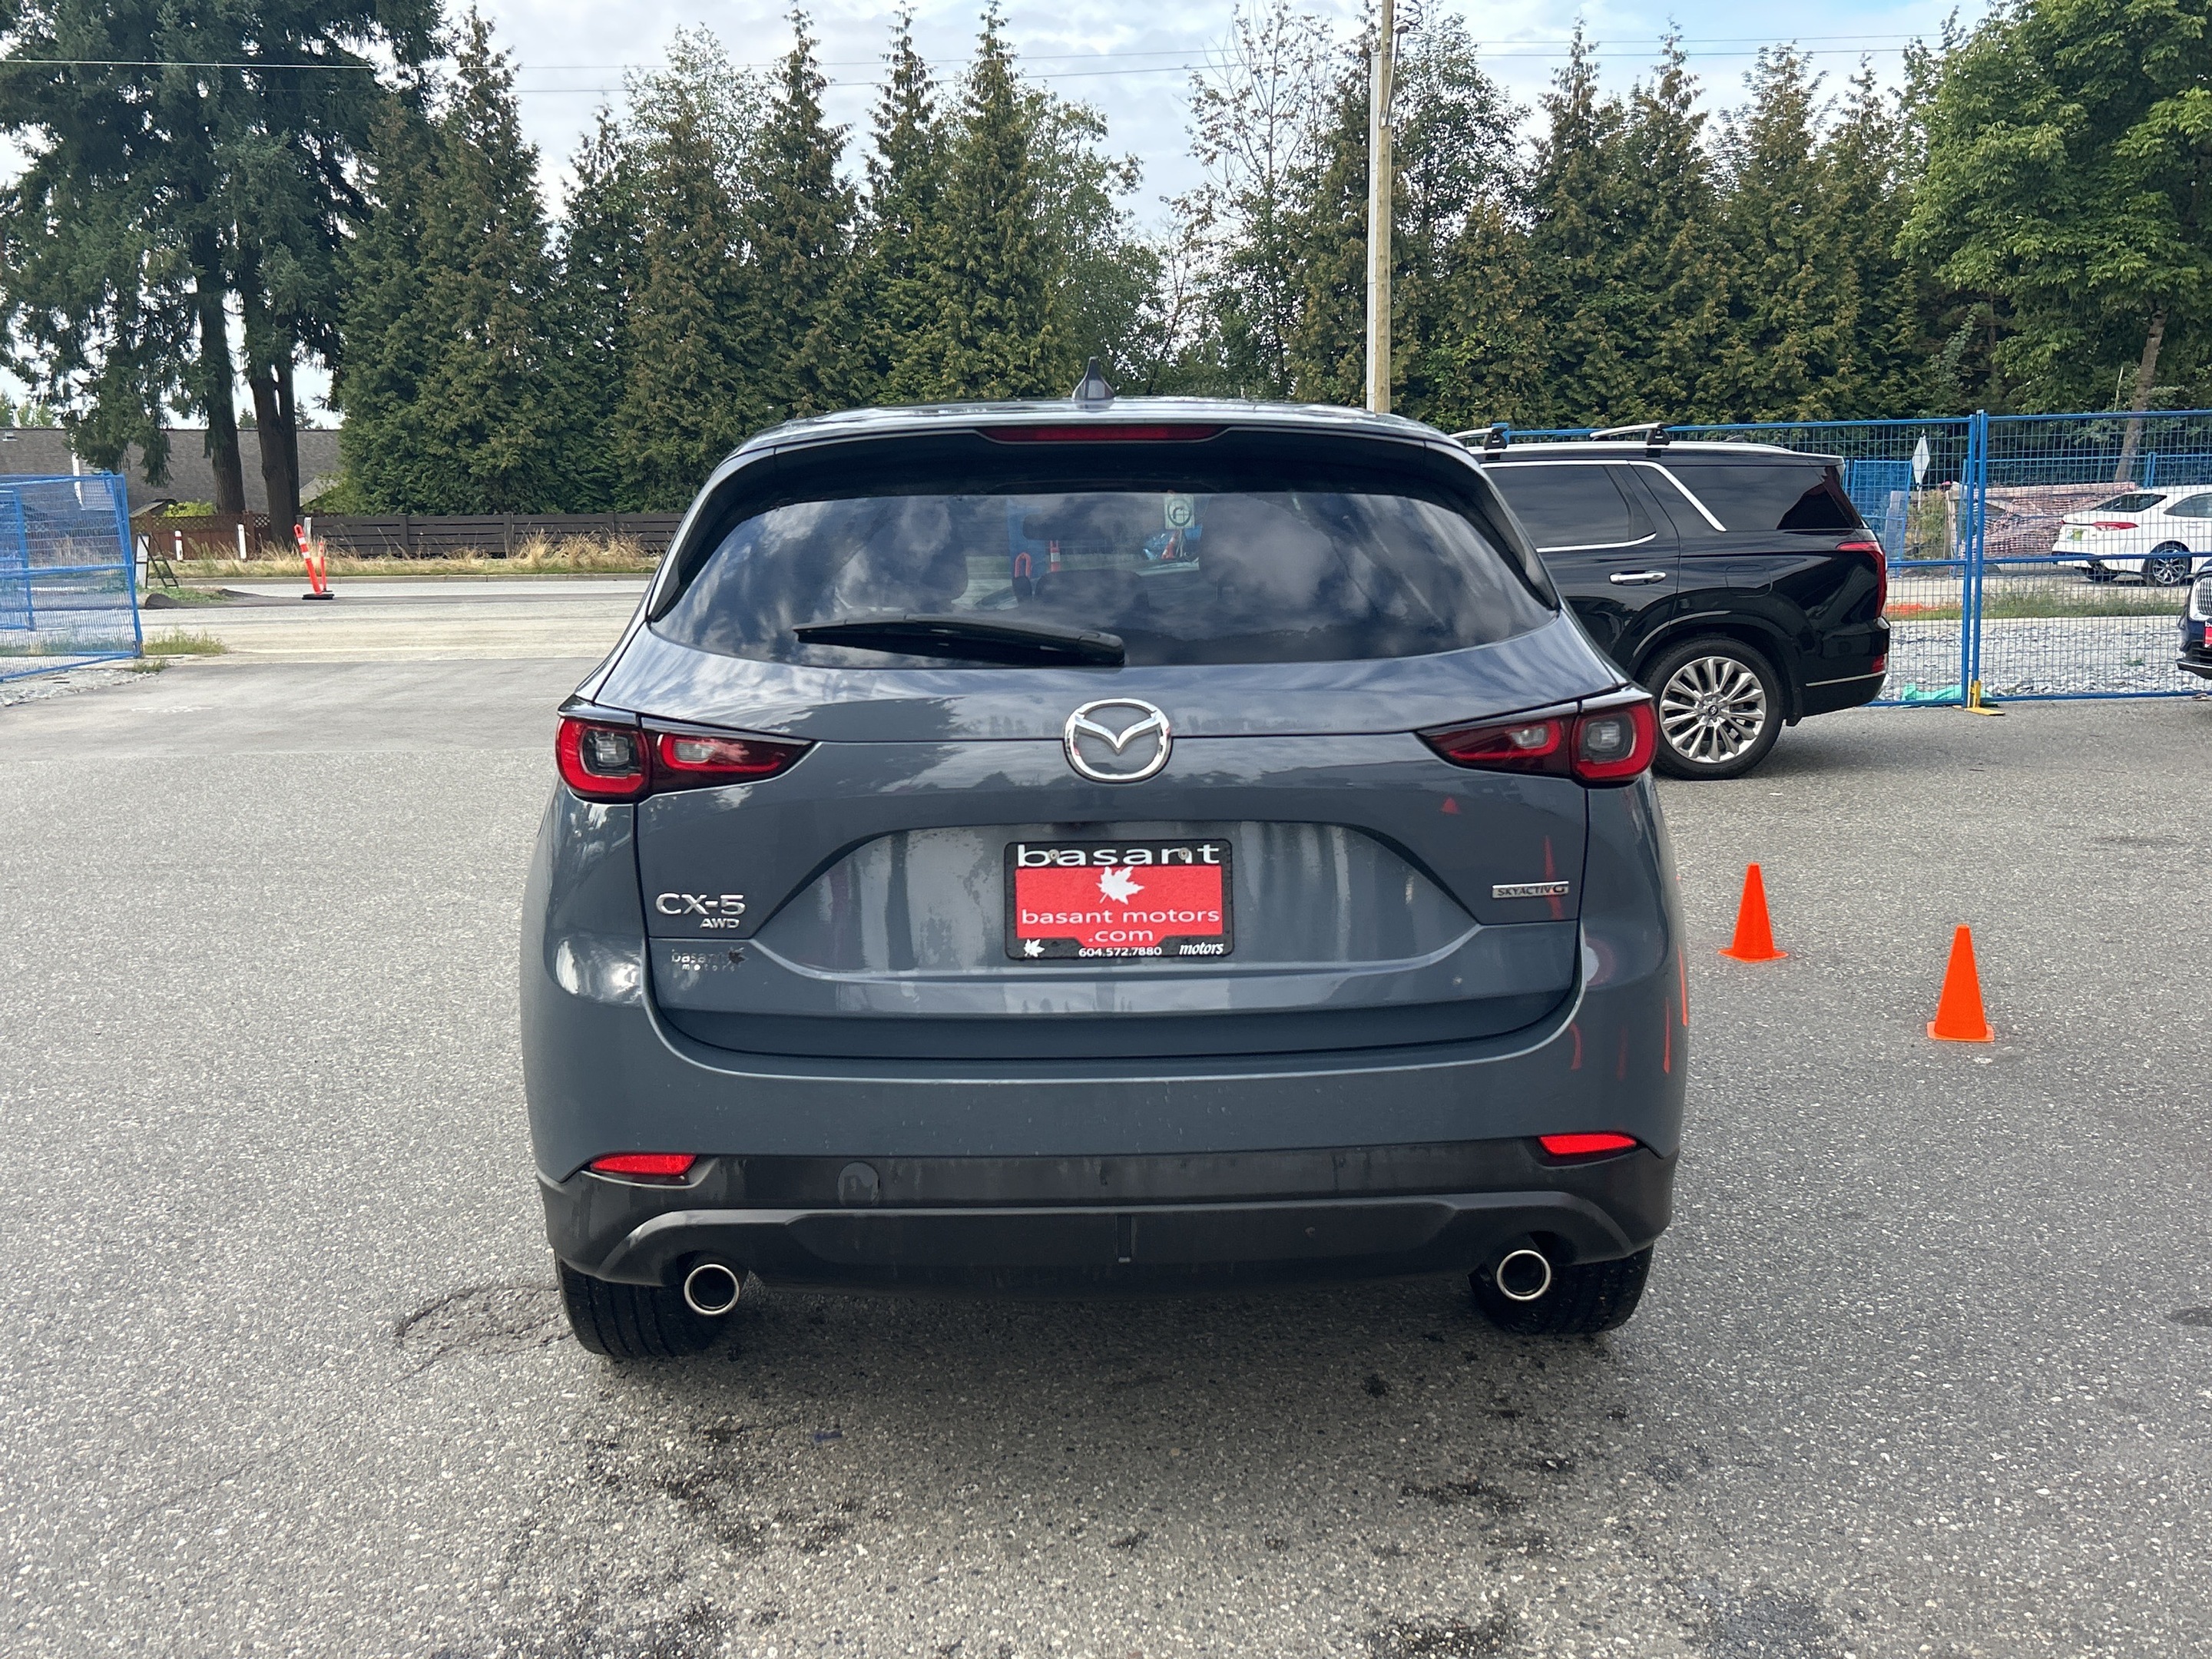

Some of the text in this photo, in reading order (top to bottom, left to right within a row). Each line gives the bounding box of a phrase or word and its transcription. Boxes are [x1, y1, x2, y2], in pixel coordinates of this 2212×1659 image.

[1018, 844, 1220, 866] basant
[656, 893, 745, 915] CX-5
[1022, 909, 1220, 924] basant motors
[700, 918, 740, 929] AWD
[1088, 929, 1153, 942] .com
[1078, 946, 1162, 957] 604.572.7880
[1179, 942, 1224, 955] motors
